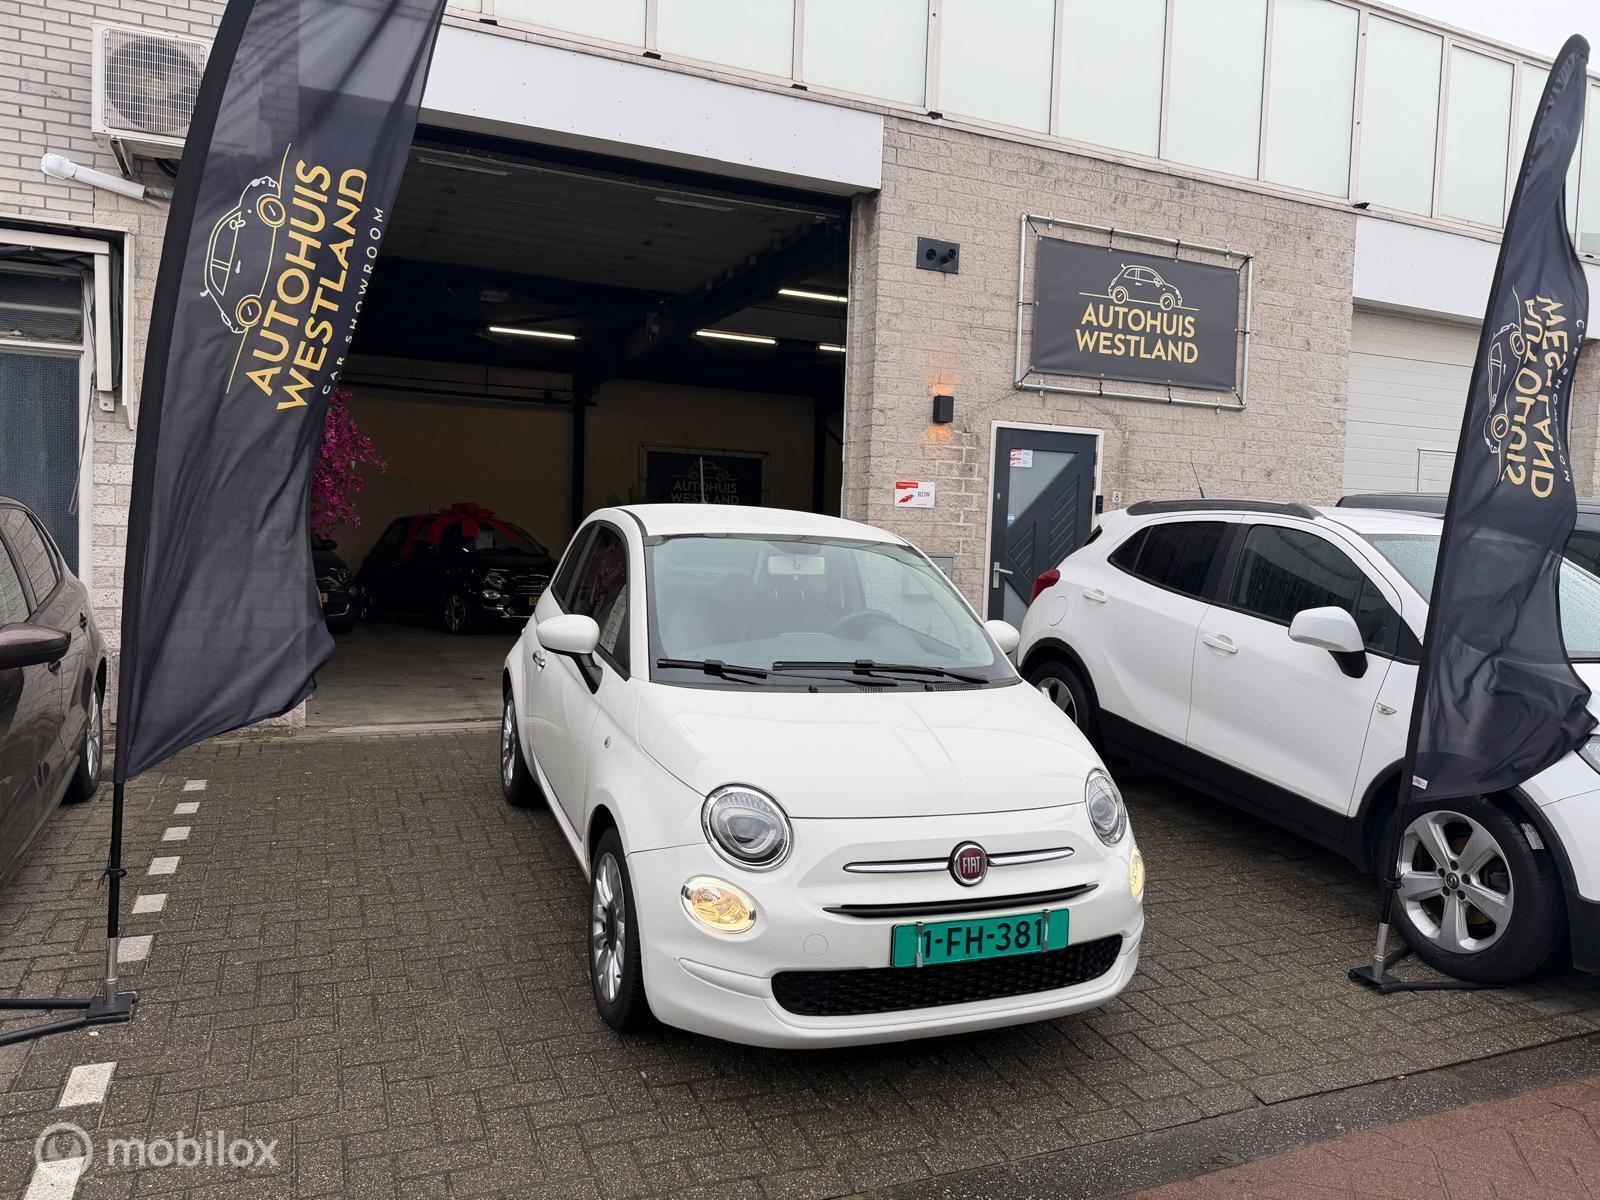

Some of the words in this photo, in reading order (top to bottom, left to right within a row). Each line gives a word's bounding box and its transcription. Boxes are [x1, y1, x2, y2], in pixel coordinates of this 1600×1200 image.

[245, 159, 331, 397] AUTOHUIS
[276, 168, 368, 411] WESTLAND
[322, 356, 345, 395] CAR
[345, 207, 384, 344] SHOWROOM
[1081, 302, 1195, 338] AUTOHUIS
[1075, 329, 1199, 364] WESTLAND
[673, 481, 736, 493] AUTOHUIS
[962, 856, 981, 875] FIAT
[923, 918, 1043, 958] 1-FH-381
